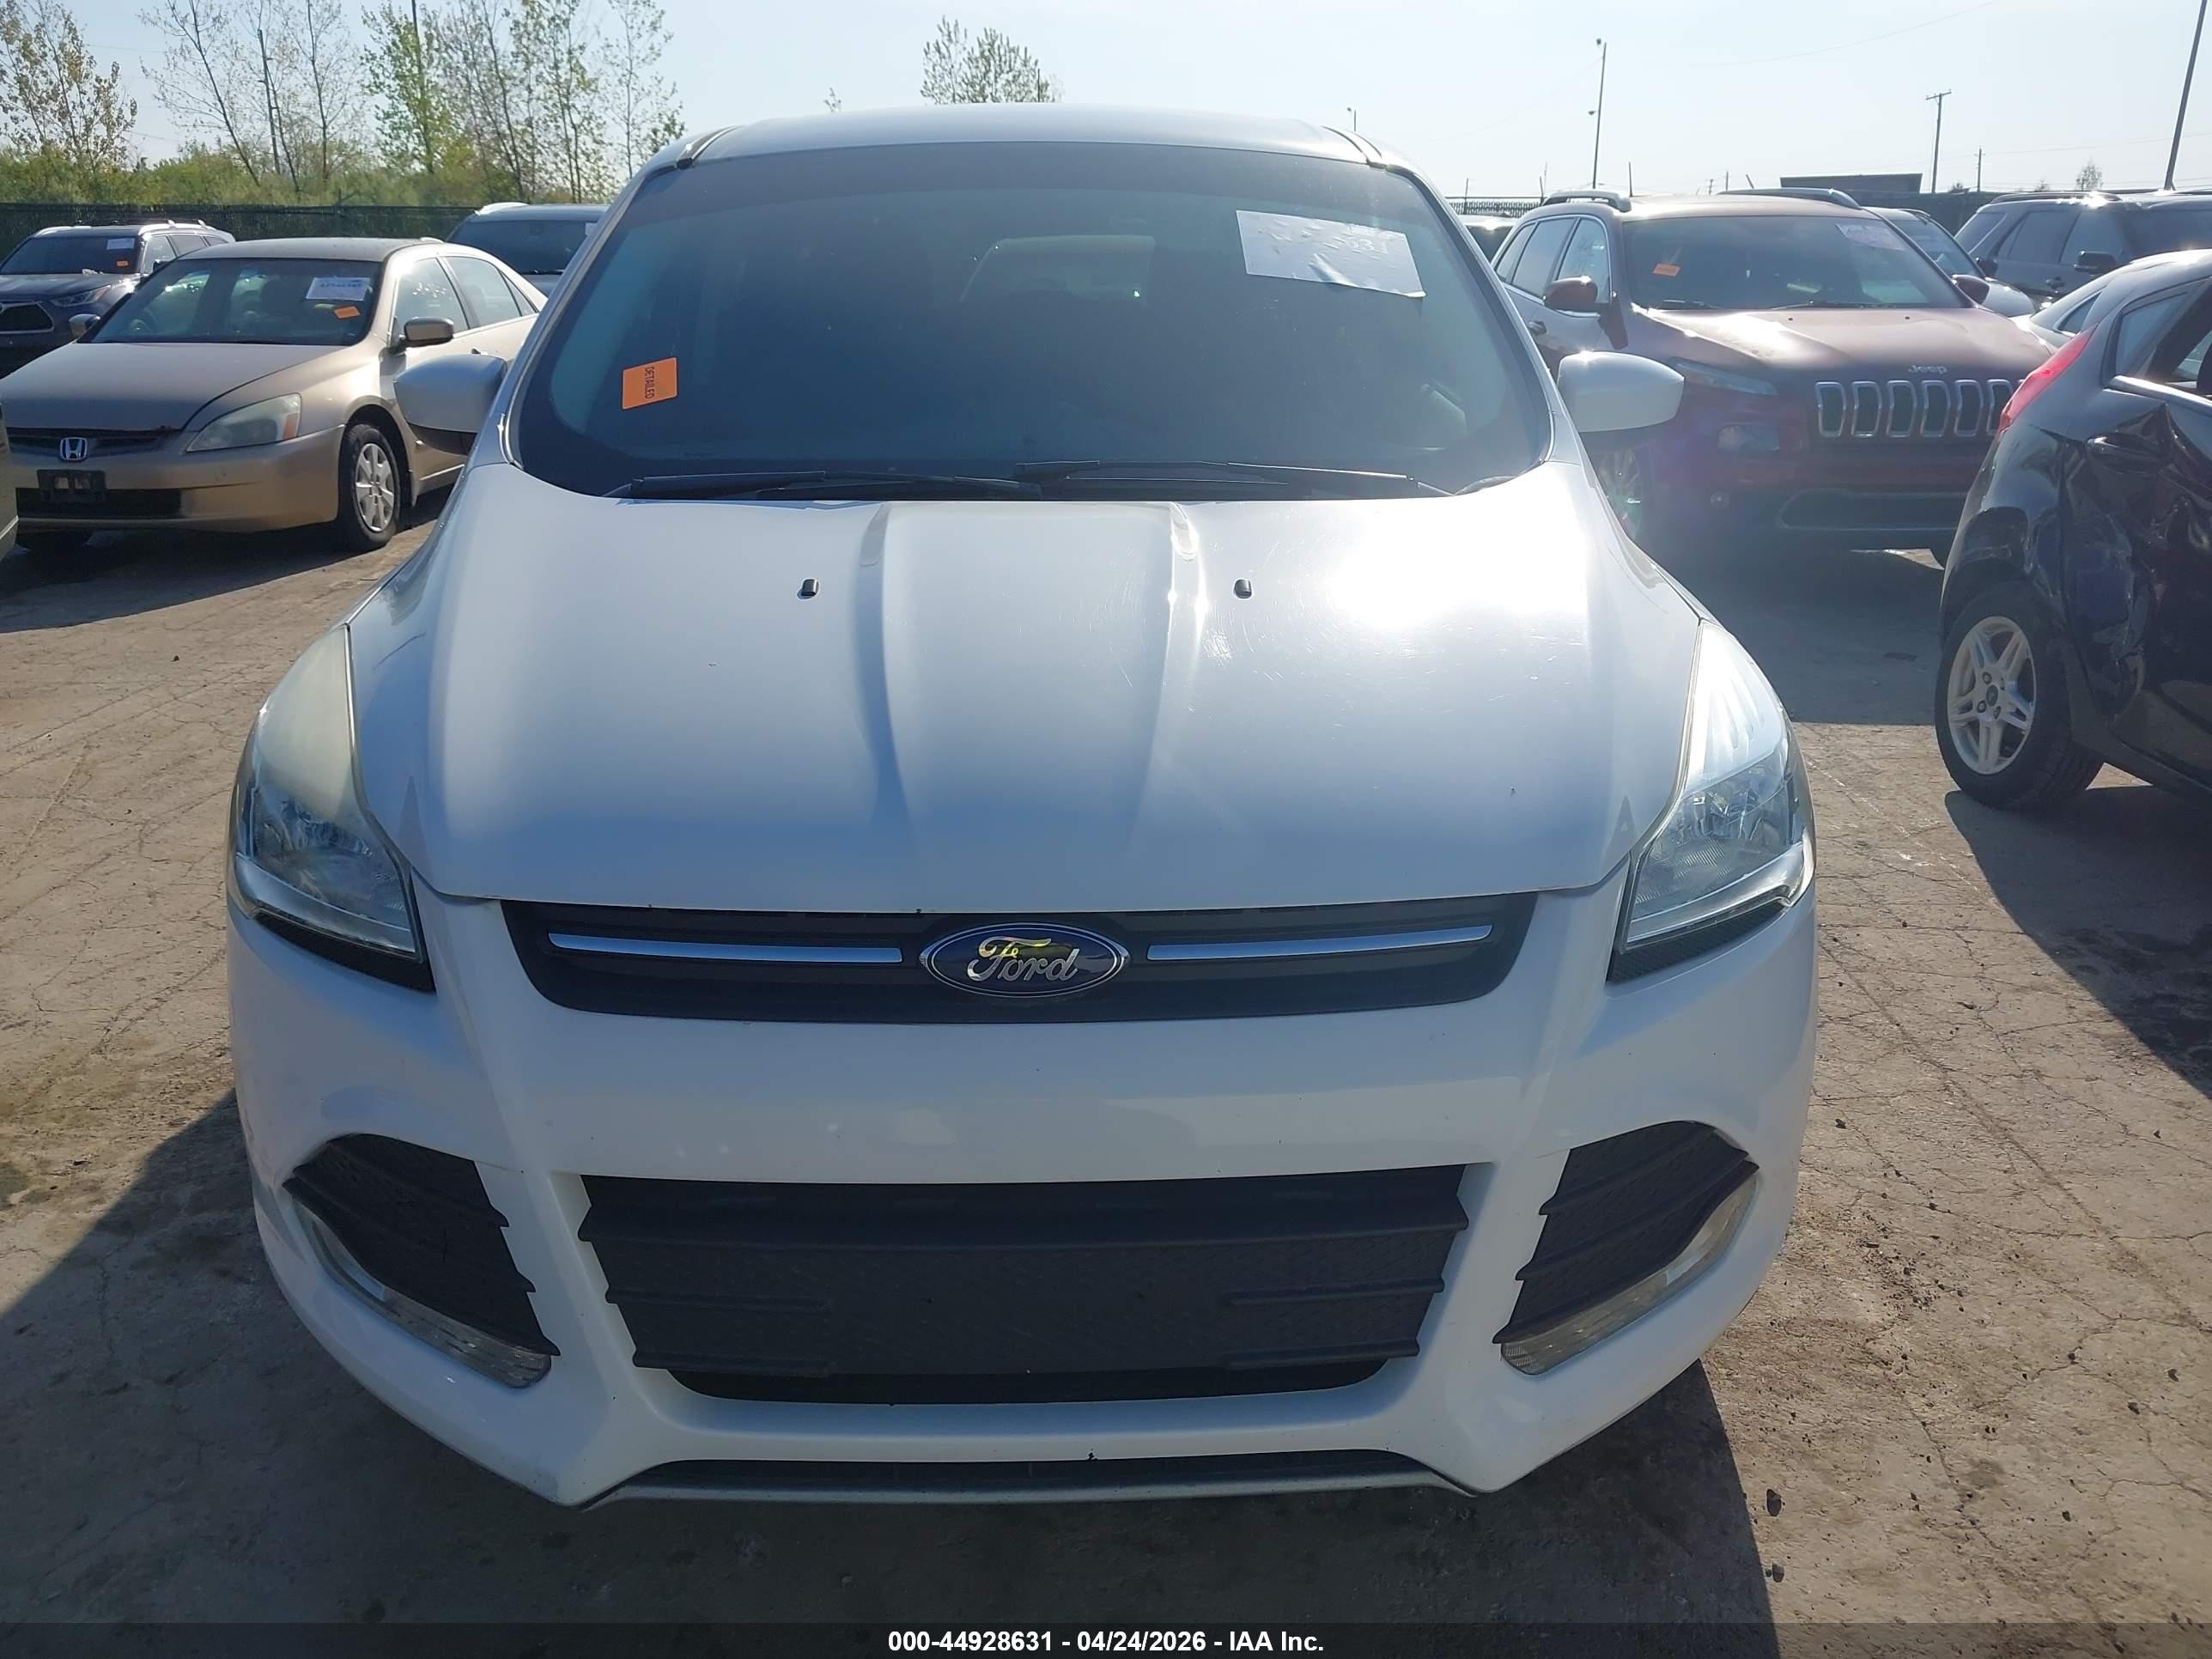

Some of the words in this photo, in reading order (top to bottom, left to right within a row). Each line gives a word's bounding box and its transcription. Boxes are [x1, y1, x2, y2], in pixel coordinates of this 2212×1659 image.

[644, 366, 654, 399] DETAILED
[1908, 365, 1948, 374] Jeep
[967, 936, 1080, 981] Ford
